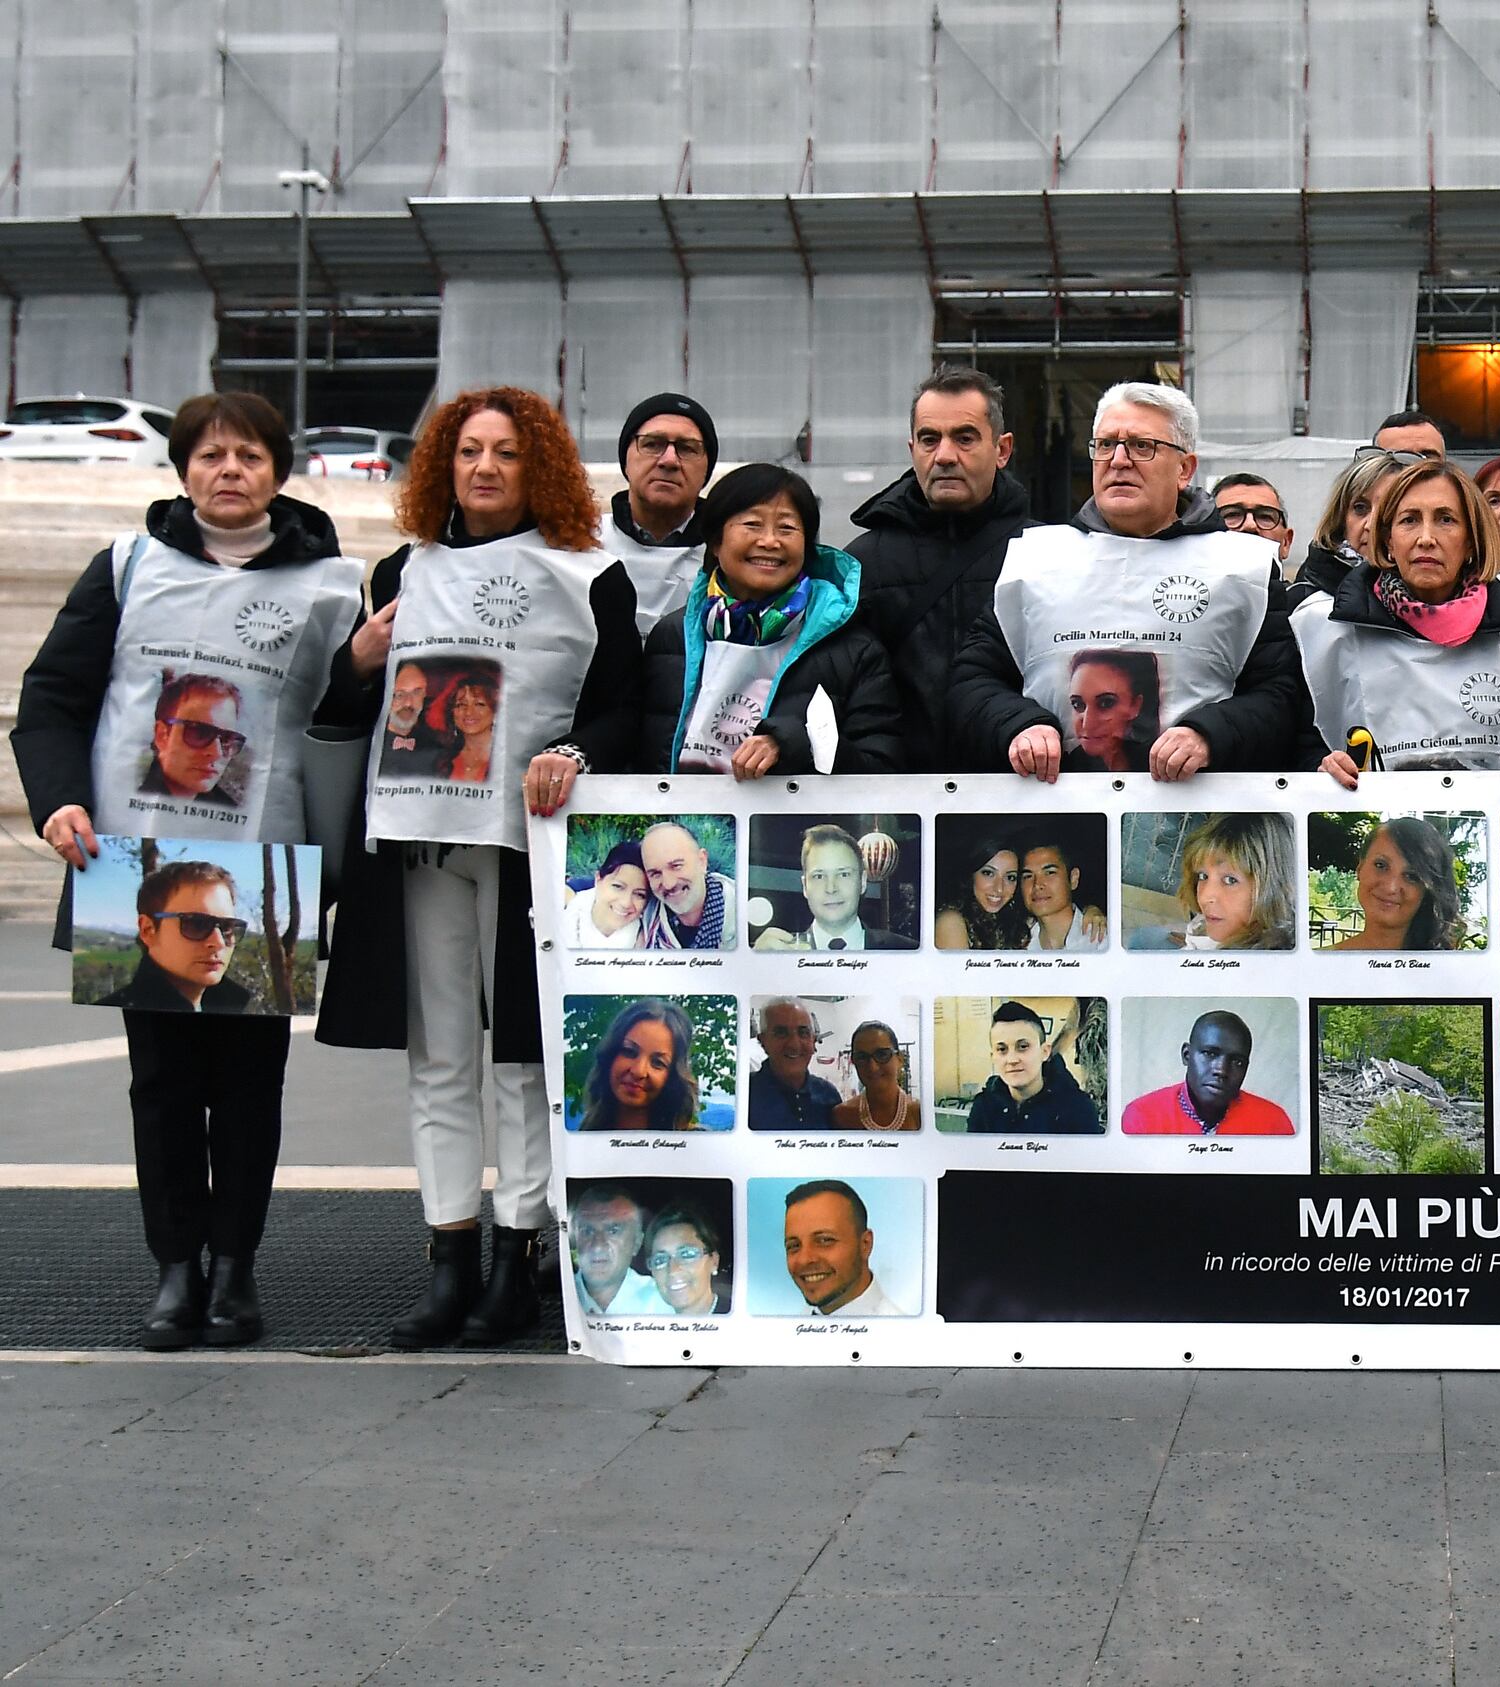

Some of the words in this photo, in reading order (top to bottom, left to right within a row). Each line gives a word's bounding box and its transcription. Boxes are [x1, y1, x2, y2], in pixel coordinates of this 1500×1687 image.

[1155, 575, 1208, 594] COMITATO
[1153, 598, 1208, 623] RIGOPIANO
[458, 636, 480, 646] anni
[483, 636, 494, 647] 52
[505, 641, 516, 651] 48
[1053, 631, 1086, 643] Cecilia
[1089, 630, 1139, 642] Martella,
[1142, 631, 1166, 641] anni
[1169, 631, 1182, 642] 24
[1472, 695, 1500, 703] VITTIME
[709, 746, 721, 757] 25
[1379, 741, 1417, 755] alentina
[1420, 735, 1462, 748] Cicioni,
[1465, 734, 1487, 746] anni
[1489, 734, 1499, 747] 32
[430, 784, 494, 800] 18/01/2017
[183, 805, 248, 825] 18/01/2017
[836, 958, 868, 970] Bonifazi
[965, 959, 991, 970] Jessica
[994, 959, 1018, 968] Tinari
[1027, 959, 1052, 968] Marco
[1055, 959, 1080, 968] Tanda
[1180, 959, 1205, 968] Linda
[1208, 959, 1240, 970] Salzetta
[1394, 959, 1407, 968] Di
[1409, 959, 1431, 968] Biase
[610, 1139, 649, 1148] Marinella
[1188, 1143, 1208, 1154] Faye
[1210, 1143, 1233, 1152] Dame
[1299, 1197, 1397, 1238] MAI
[1204, 1252, 1224, 1272] in
[1231, 1252, 1311, 1273] ricordo
[1318, 1252, 1372, 1273] delle
[1379, 1252, 1454, 1273] vittime
[1461, 1252, 1482, 1274] di
[1340, 1286, 1470, 1308] 18/01/2017
